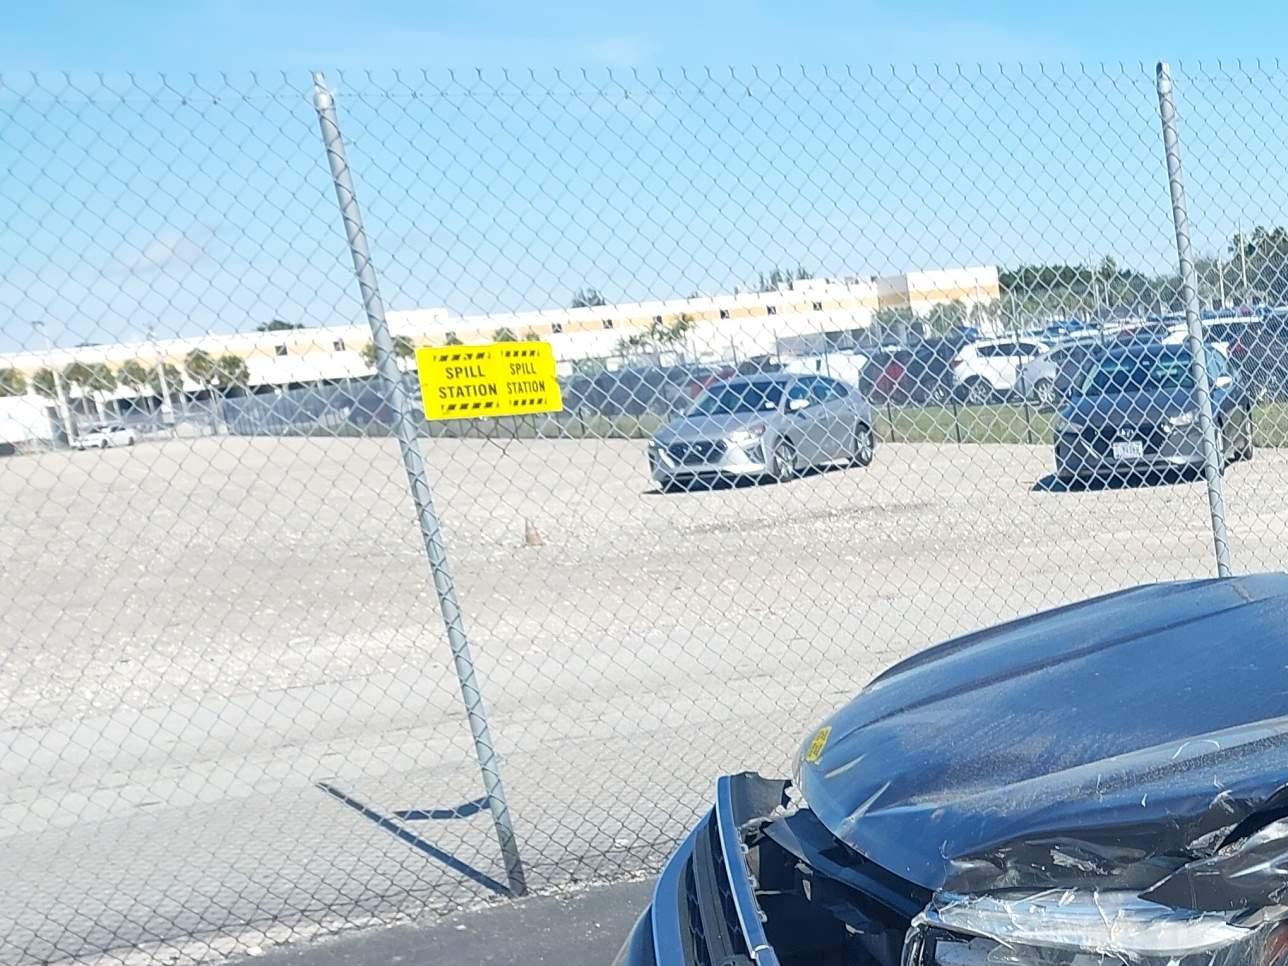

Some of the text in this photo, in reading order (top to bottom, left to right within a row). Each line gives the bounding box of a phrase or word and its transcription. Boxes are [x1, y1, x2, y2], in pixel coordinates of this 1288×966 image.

[445, 365, 486, 380] SPILL
[509, 362, 537, 376] SPILL
[438, 383, 498, 400] STATION
[506, 380, 546, 395] STATION
